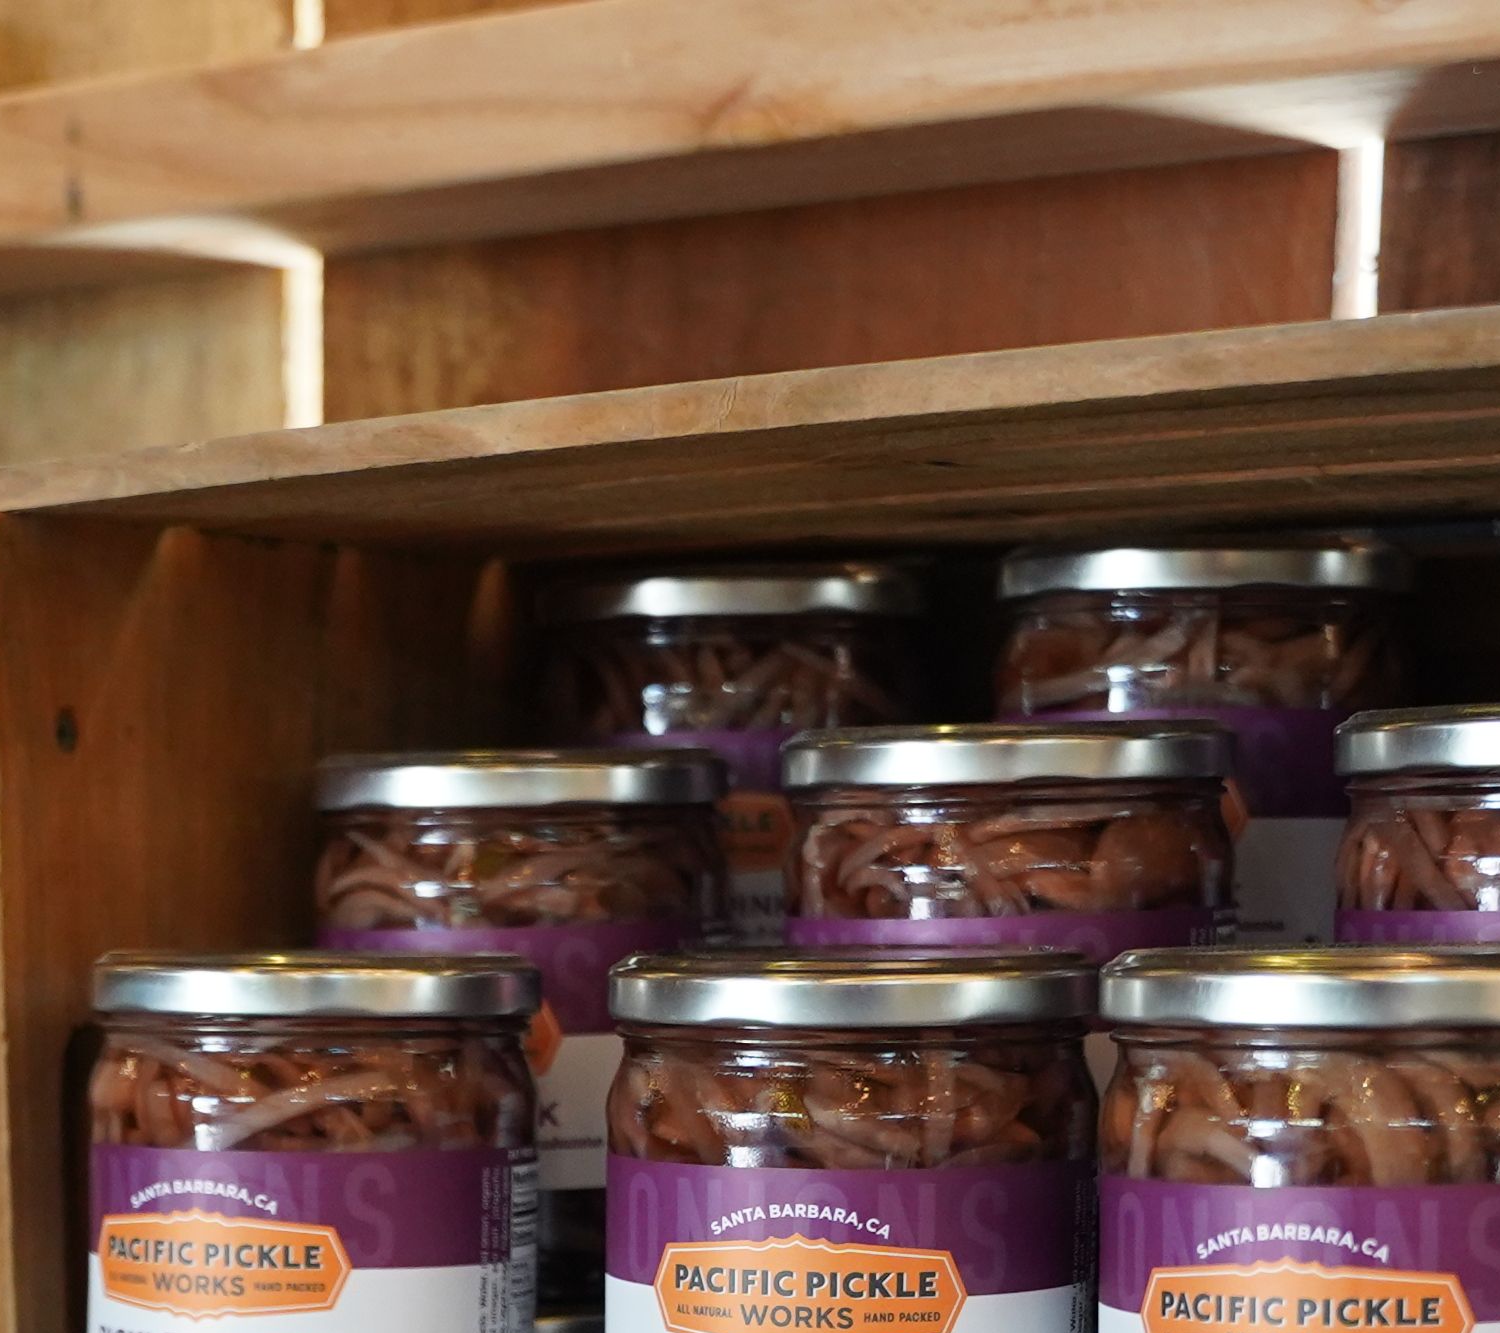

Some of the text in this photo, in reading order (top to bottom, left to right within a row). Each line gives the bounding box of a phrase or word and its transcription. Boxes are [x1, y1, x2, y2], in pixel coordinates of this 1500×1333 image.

[711, 1206, 766, 1235] SANTA
[866, 1216, 891, 1239] CA
[108, 1236, 322, 1269] PACIFIC PICKLE
[1197, 1227, 1254, 1259] SANTA
[1362, 1238, 1391, 1264] CA
[152, 1272, 245, 1296] WORKS
[674, 1264, 938, 1299] PACIFIC PICKLE
[676, 1304, 941, 1329] ALL NATURAL WORKS HAND PACKED
[1160, 1290, 1441, 1328] PACIFIC PICKLE
